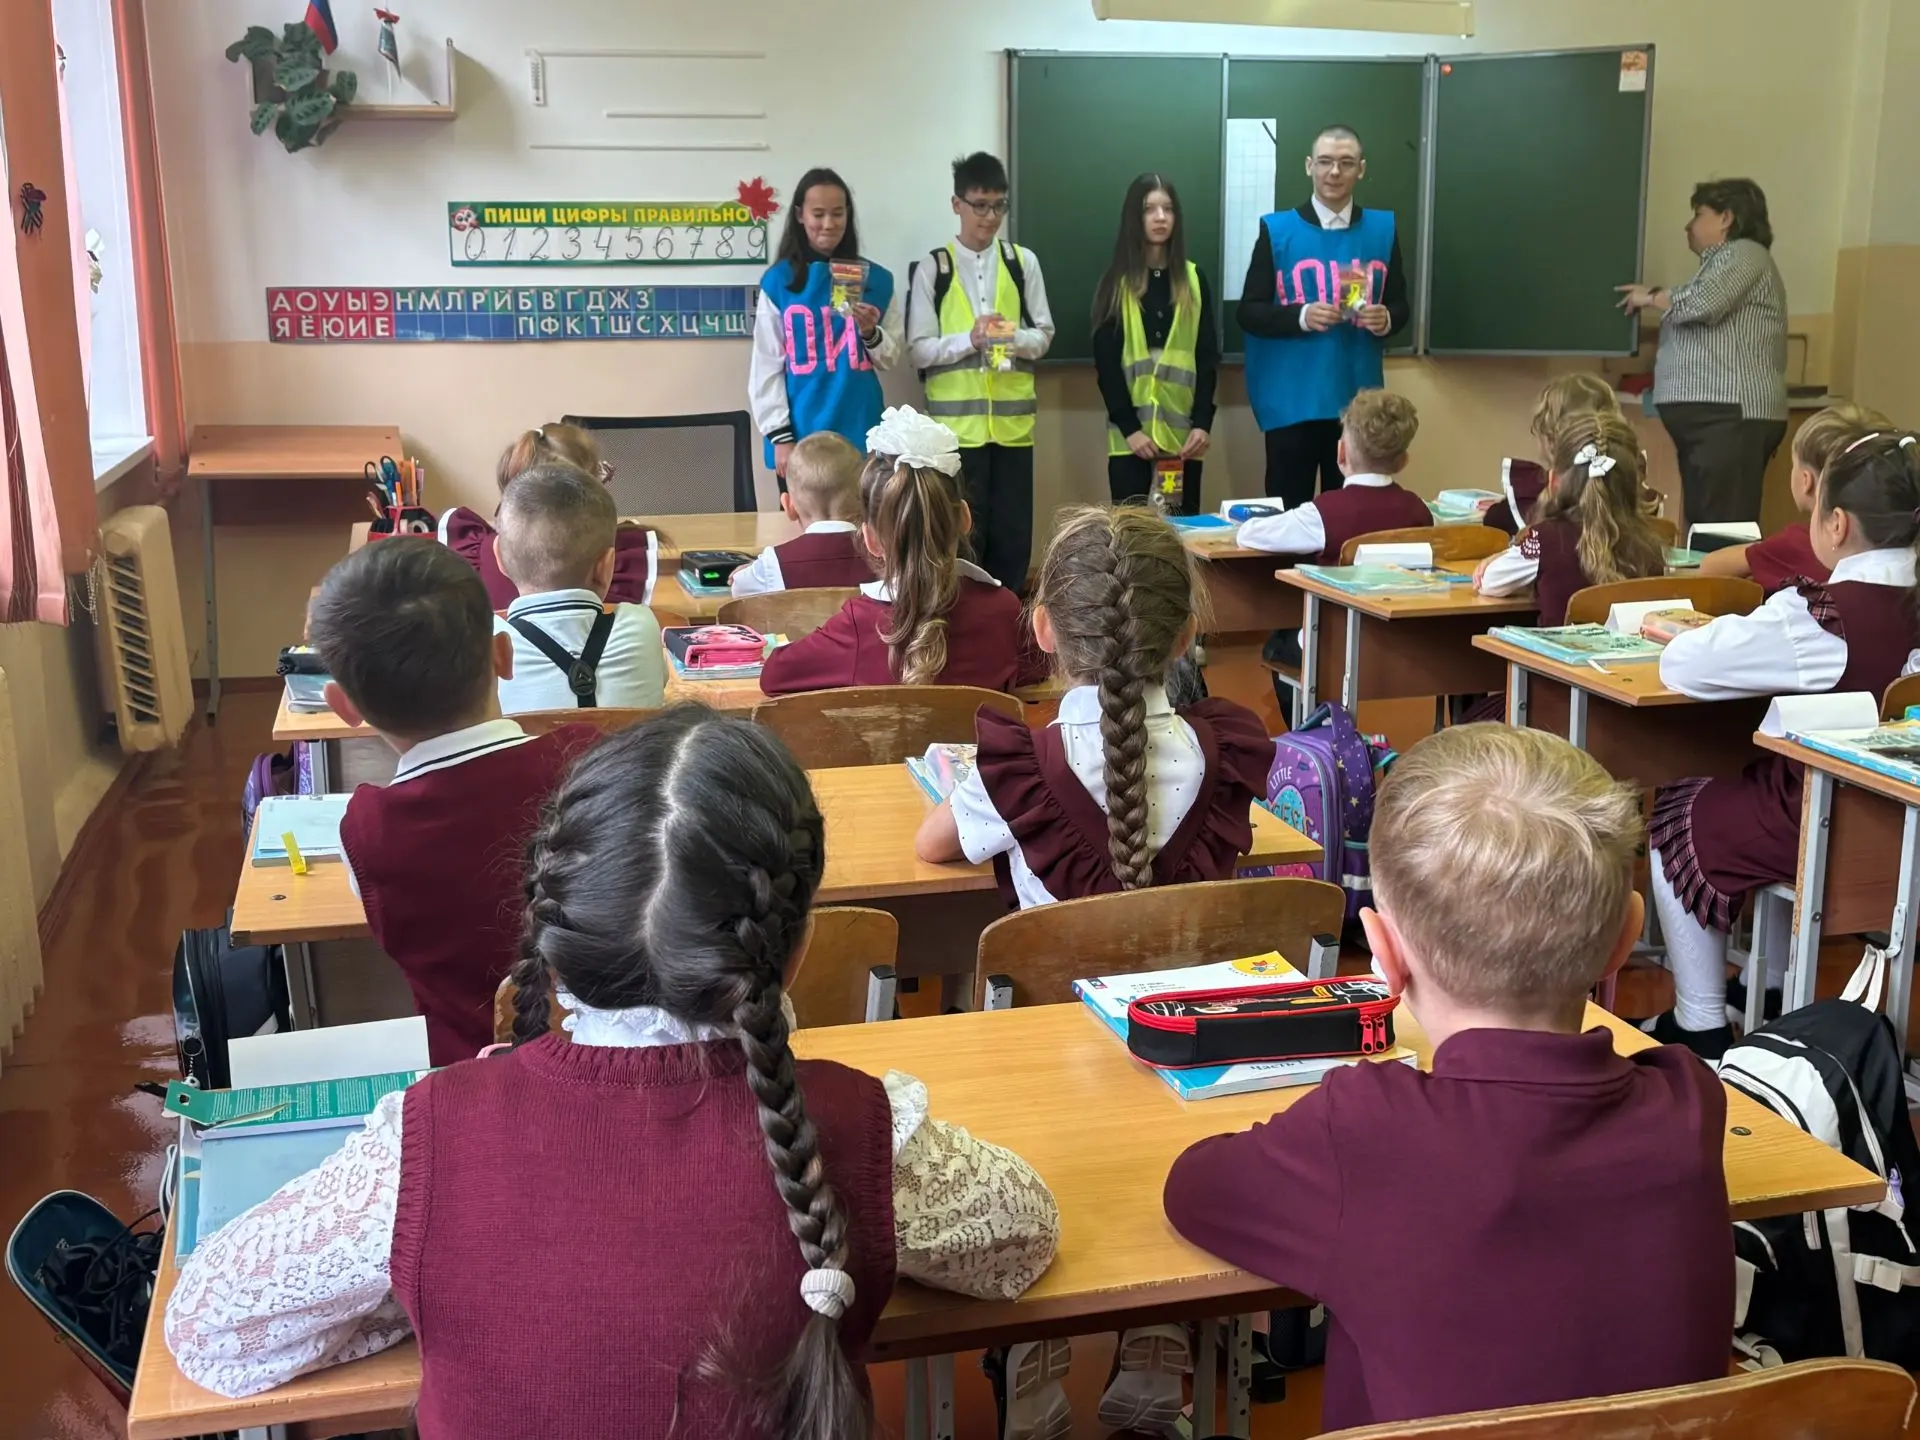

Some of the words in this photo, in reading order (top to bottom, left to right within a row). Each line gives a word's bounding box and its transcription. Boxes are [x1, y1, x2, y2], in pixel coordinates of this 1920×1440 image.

[484, 207, 547, 224] ПИШИ
[552, 206, 628, 225] ЦИФРЫ
[633, 207, 751, 224] ПРАВИЛЬНО
[464, 226, 486, 261] 0
[503, 227, 517, 261] 1
[529, 227, 550, 260] 2
[561, 226, 581, 260] 3
[594, 227, 613, 261] 4
[625, 226, 644, 260] 5
[653, 226, 675, 260] 6
[685, 226, 704, 259] 7
[714, 226, 735, 259] 8
[747, 226, 767, 259] 9
[1269, 766, 1292, 790] LITTLE
[1250, 1062, 1295, 1071] Часть
